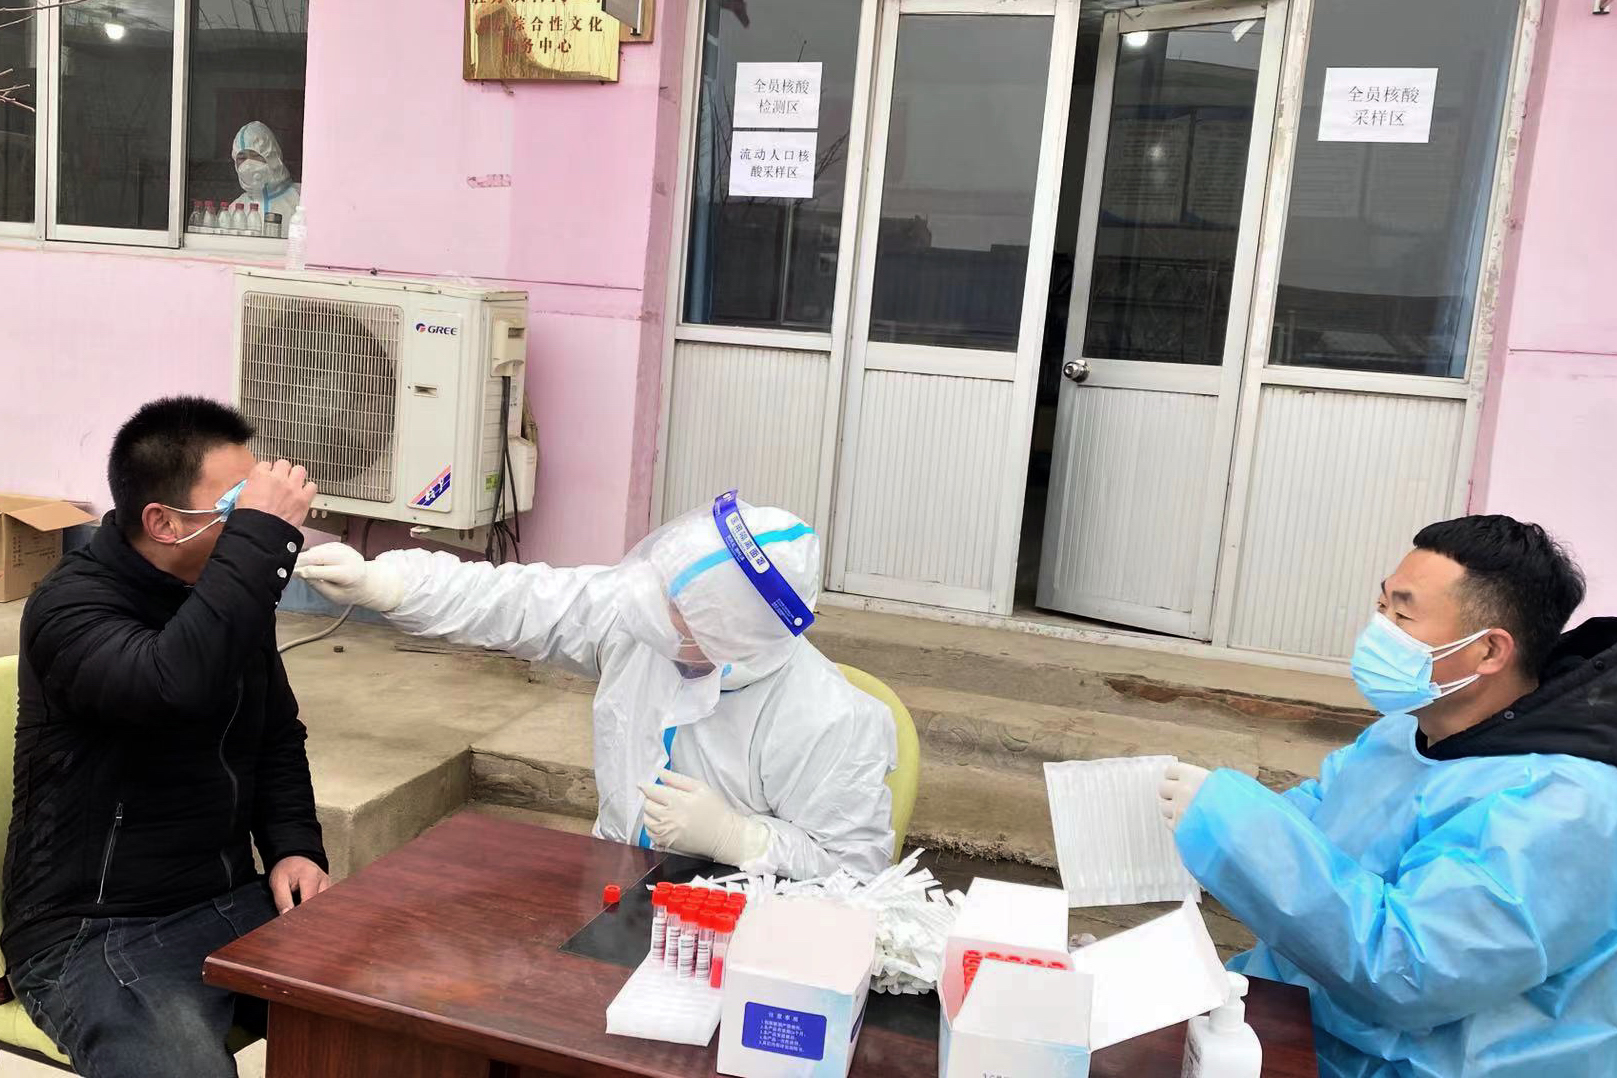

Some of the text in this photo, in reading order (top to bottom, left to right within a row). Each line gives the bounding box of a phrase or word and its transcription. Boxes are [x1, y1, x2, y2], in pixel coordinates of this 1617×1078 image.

[478, 15, 603, 33] 综合性文化
[754, 78, 810, 95] 全员核酸
[1348, 86, 1420, 104] 全员核酸
[759, 99, 799, 115] 检测区
[1353, 109, 1405, 126] 采样区
[740, 148, 811, 162] 流动人口核
[750, 165, 799, 179] 酸采样区
[427, 325, 458, 336] GREE
